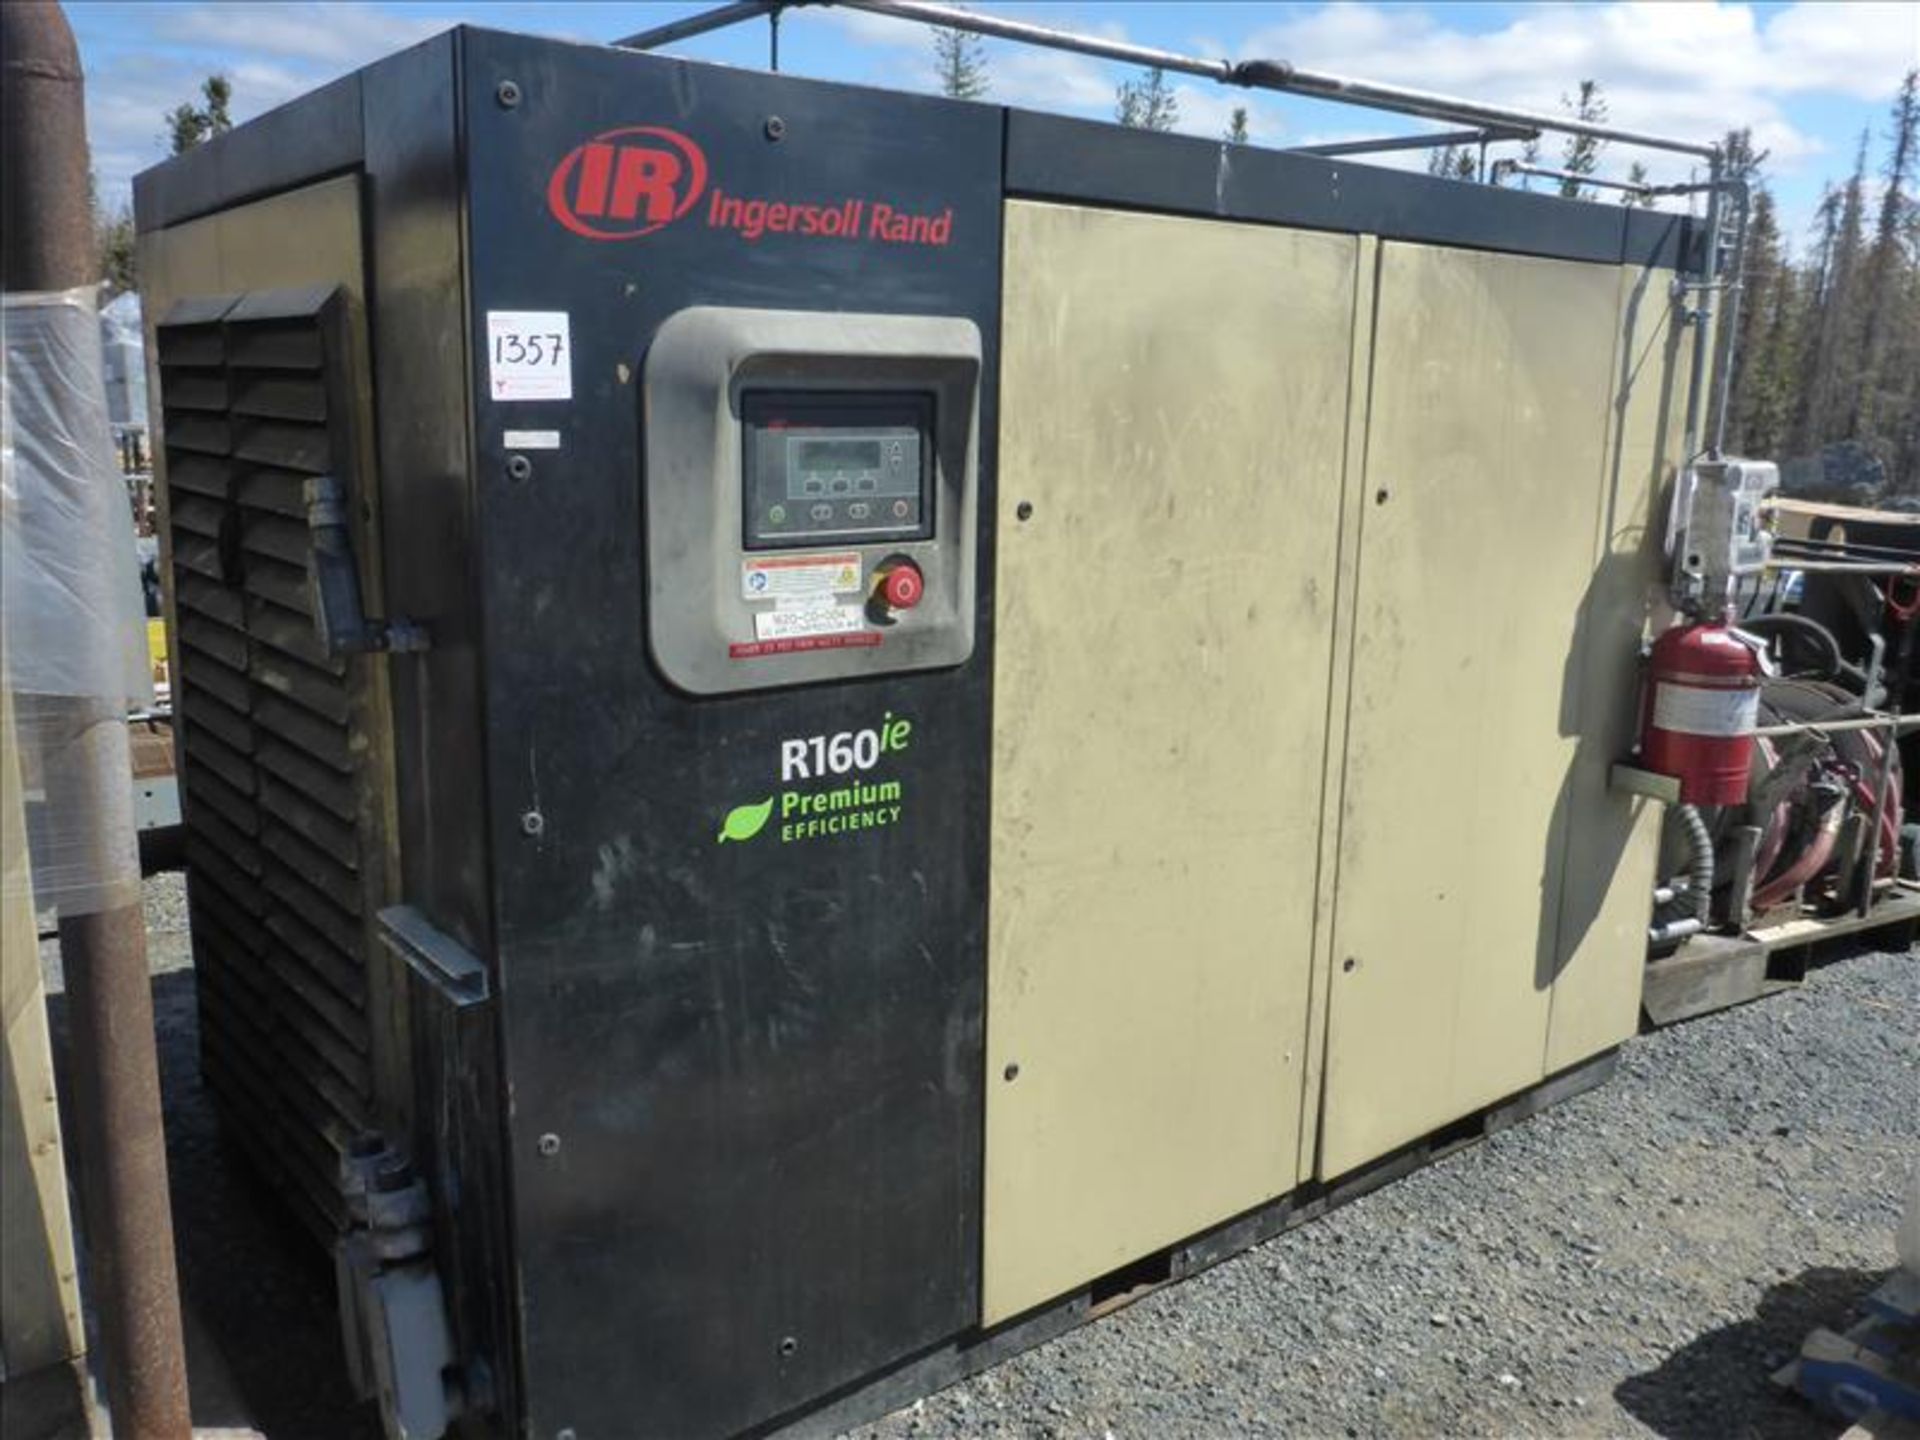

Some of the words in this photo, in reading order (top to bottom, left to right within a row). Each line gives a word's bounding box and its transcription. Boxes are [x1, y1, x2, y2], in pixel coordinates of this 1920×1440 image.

[575, 142, 682, 222] IR
[708, 188, 862, 240] Ingersoll
[868, 202, 953, 246] Rand
[495, 333, 564, 367] 1357
[781, 780, 901, 819] Premium
[781, 806, 901, 842] EFFICIENCY
